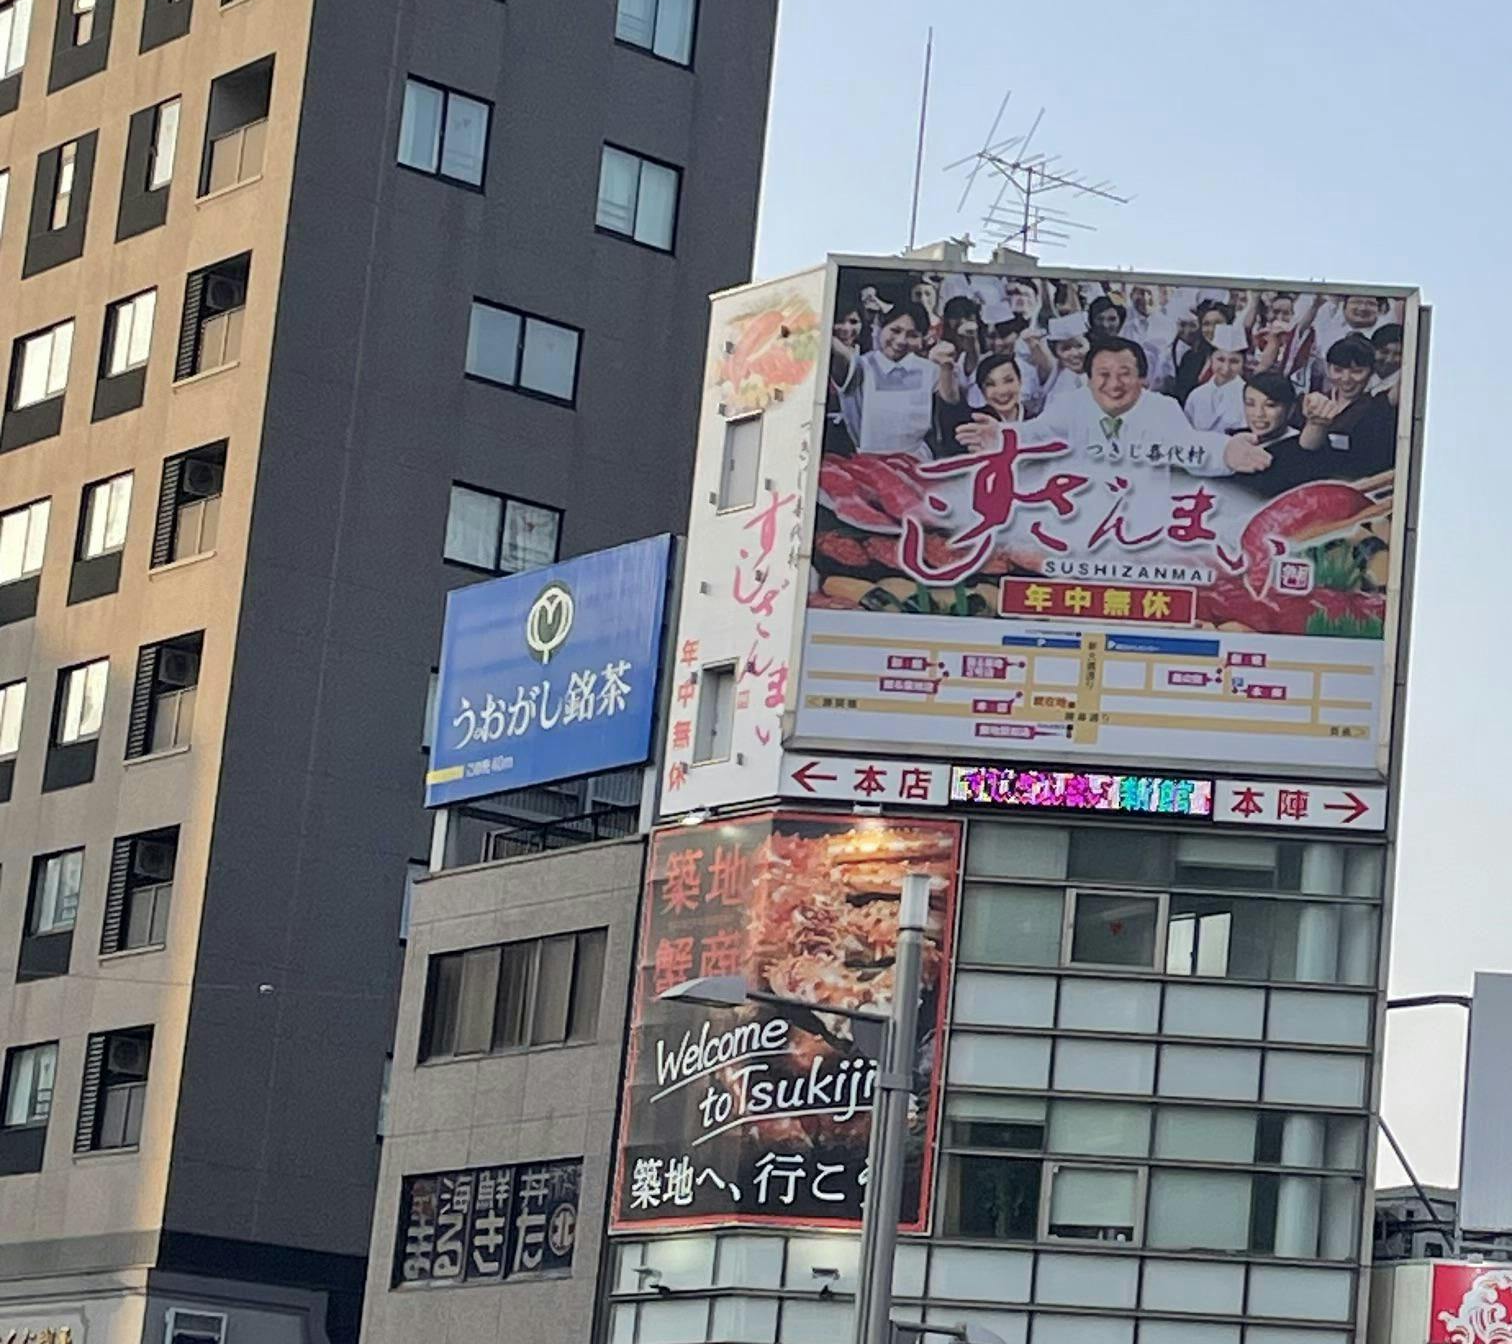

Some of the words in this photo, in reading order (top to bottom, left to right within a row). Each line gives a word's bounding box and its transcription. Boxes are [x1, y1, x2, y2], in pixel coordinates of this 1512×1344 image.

[1024, 584, 1172, 618] 年中無休
[1044, 559, 1215, 584] SUSHIZANMAI
[452, 658, 632, 751] うおがし銘茶
[668, 638, 700, 793] 年中無休
[853, 764, 932, 801] 本店
[1231, 786, 1310, 822] 本陣
[660, 842, 751, 917] 築地
[655, 1016, 790, 1087] Welcome
[699, 1086, 733, 1130] to
[732, 1056, 880, 1124] Tsukiji
[629, 1151, 873, 1211] 築地へ、行こ
